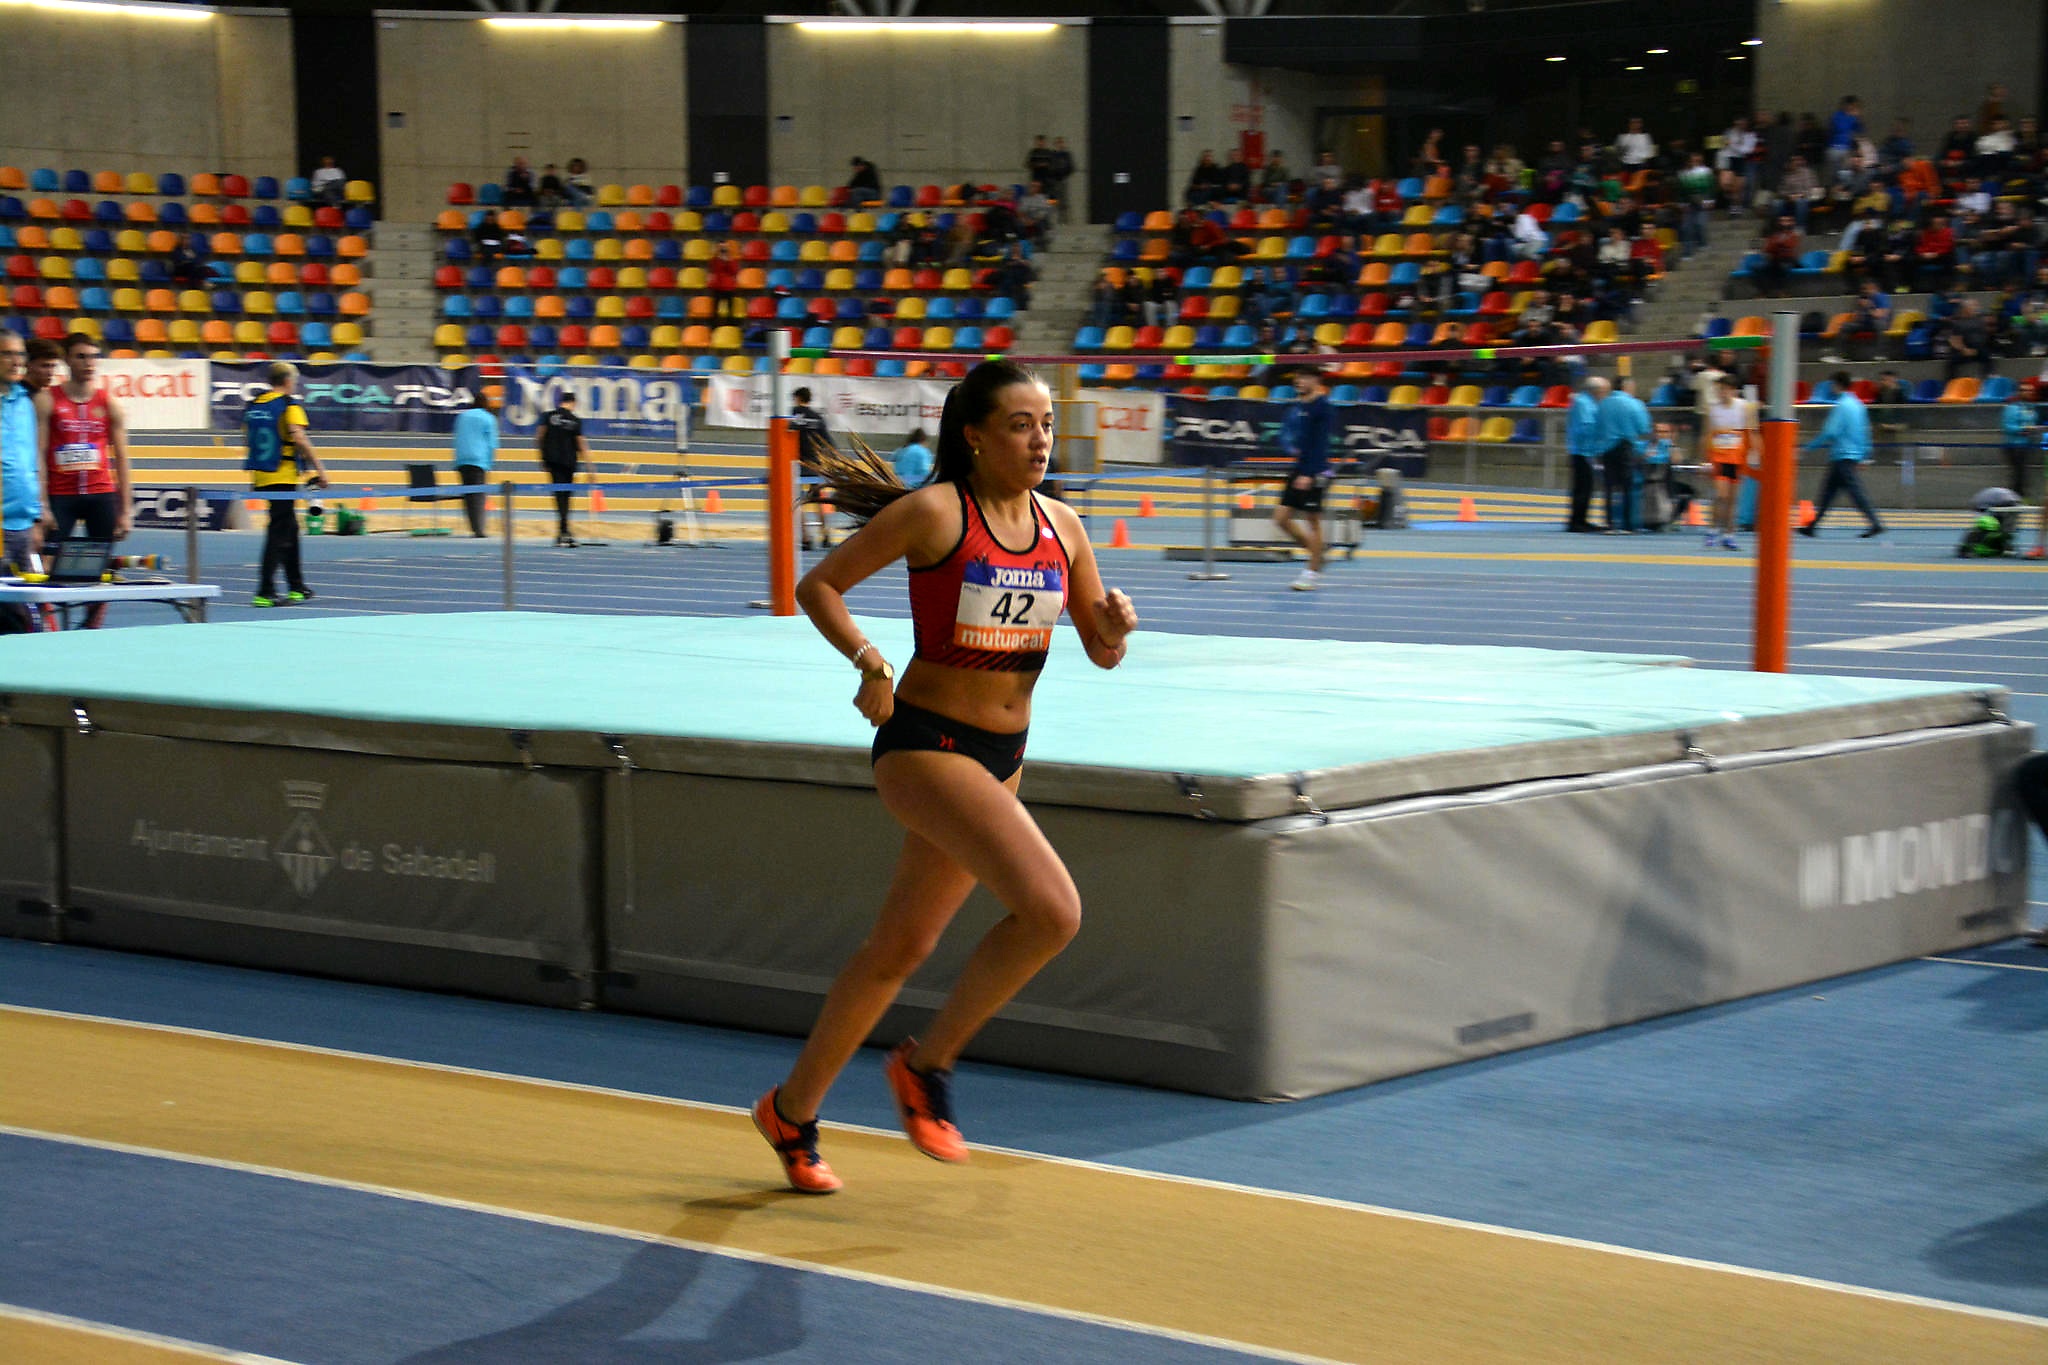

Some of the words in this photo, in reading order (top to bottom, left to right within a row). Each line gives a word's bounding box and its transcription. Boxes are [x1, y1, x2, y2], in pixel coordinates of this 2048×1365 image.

[303, 383, 394, 404] FCA
[393, 384, 476, 407] FCA
[1173, 416, 1258, 441] FCA
[1343, 424, 1427, 448] FCA
[990, 591, 1036, 626] 42
[960, 628, 1044, 651] mutuacat
